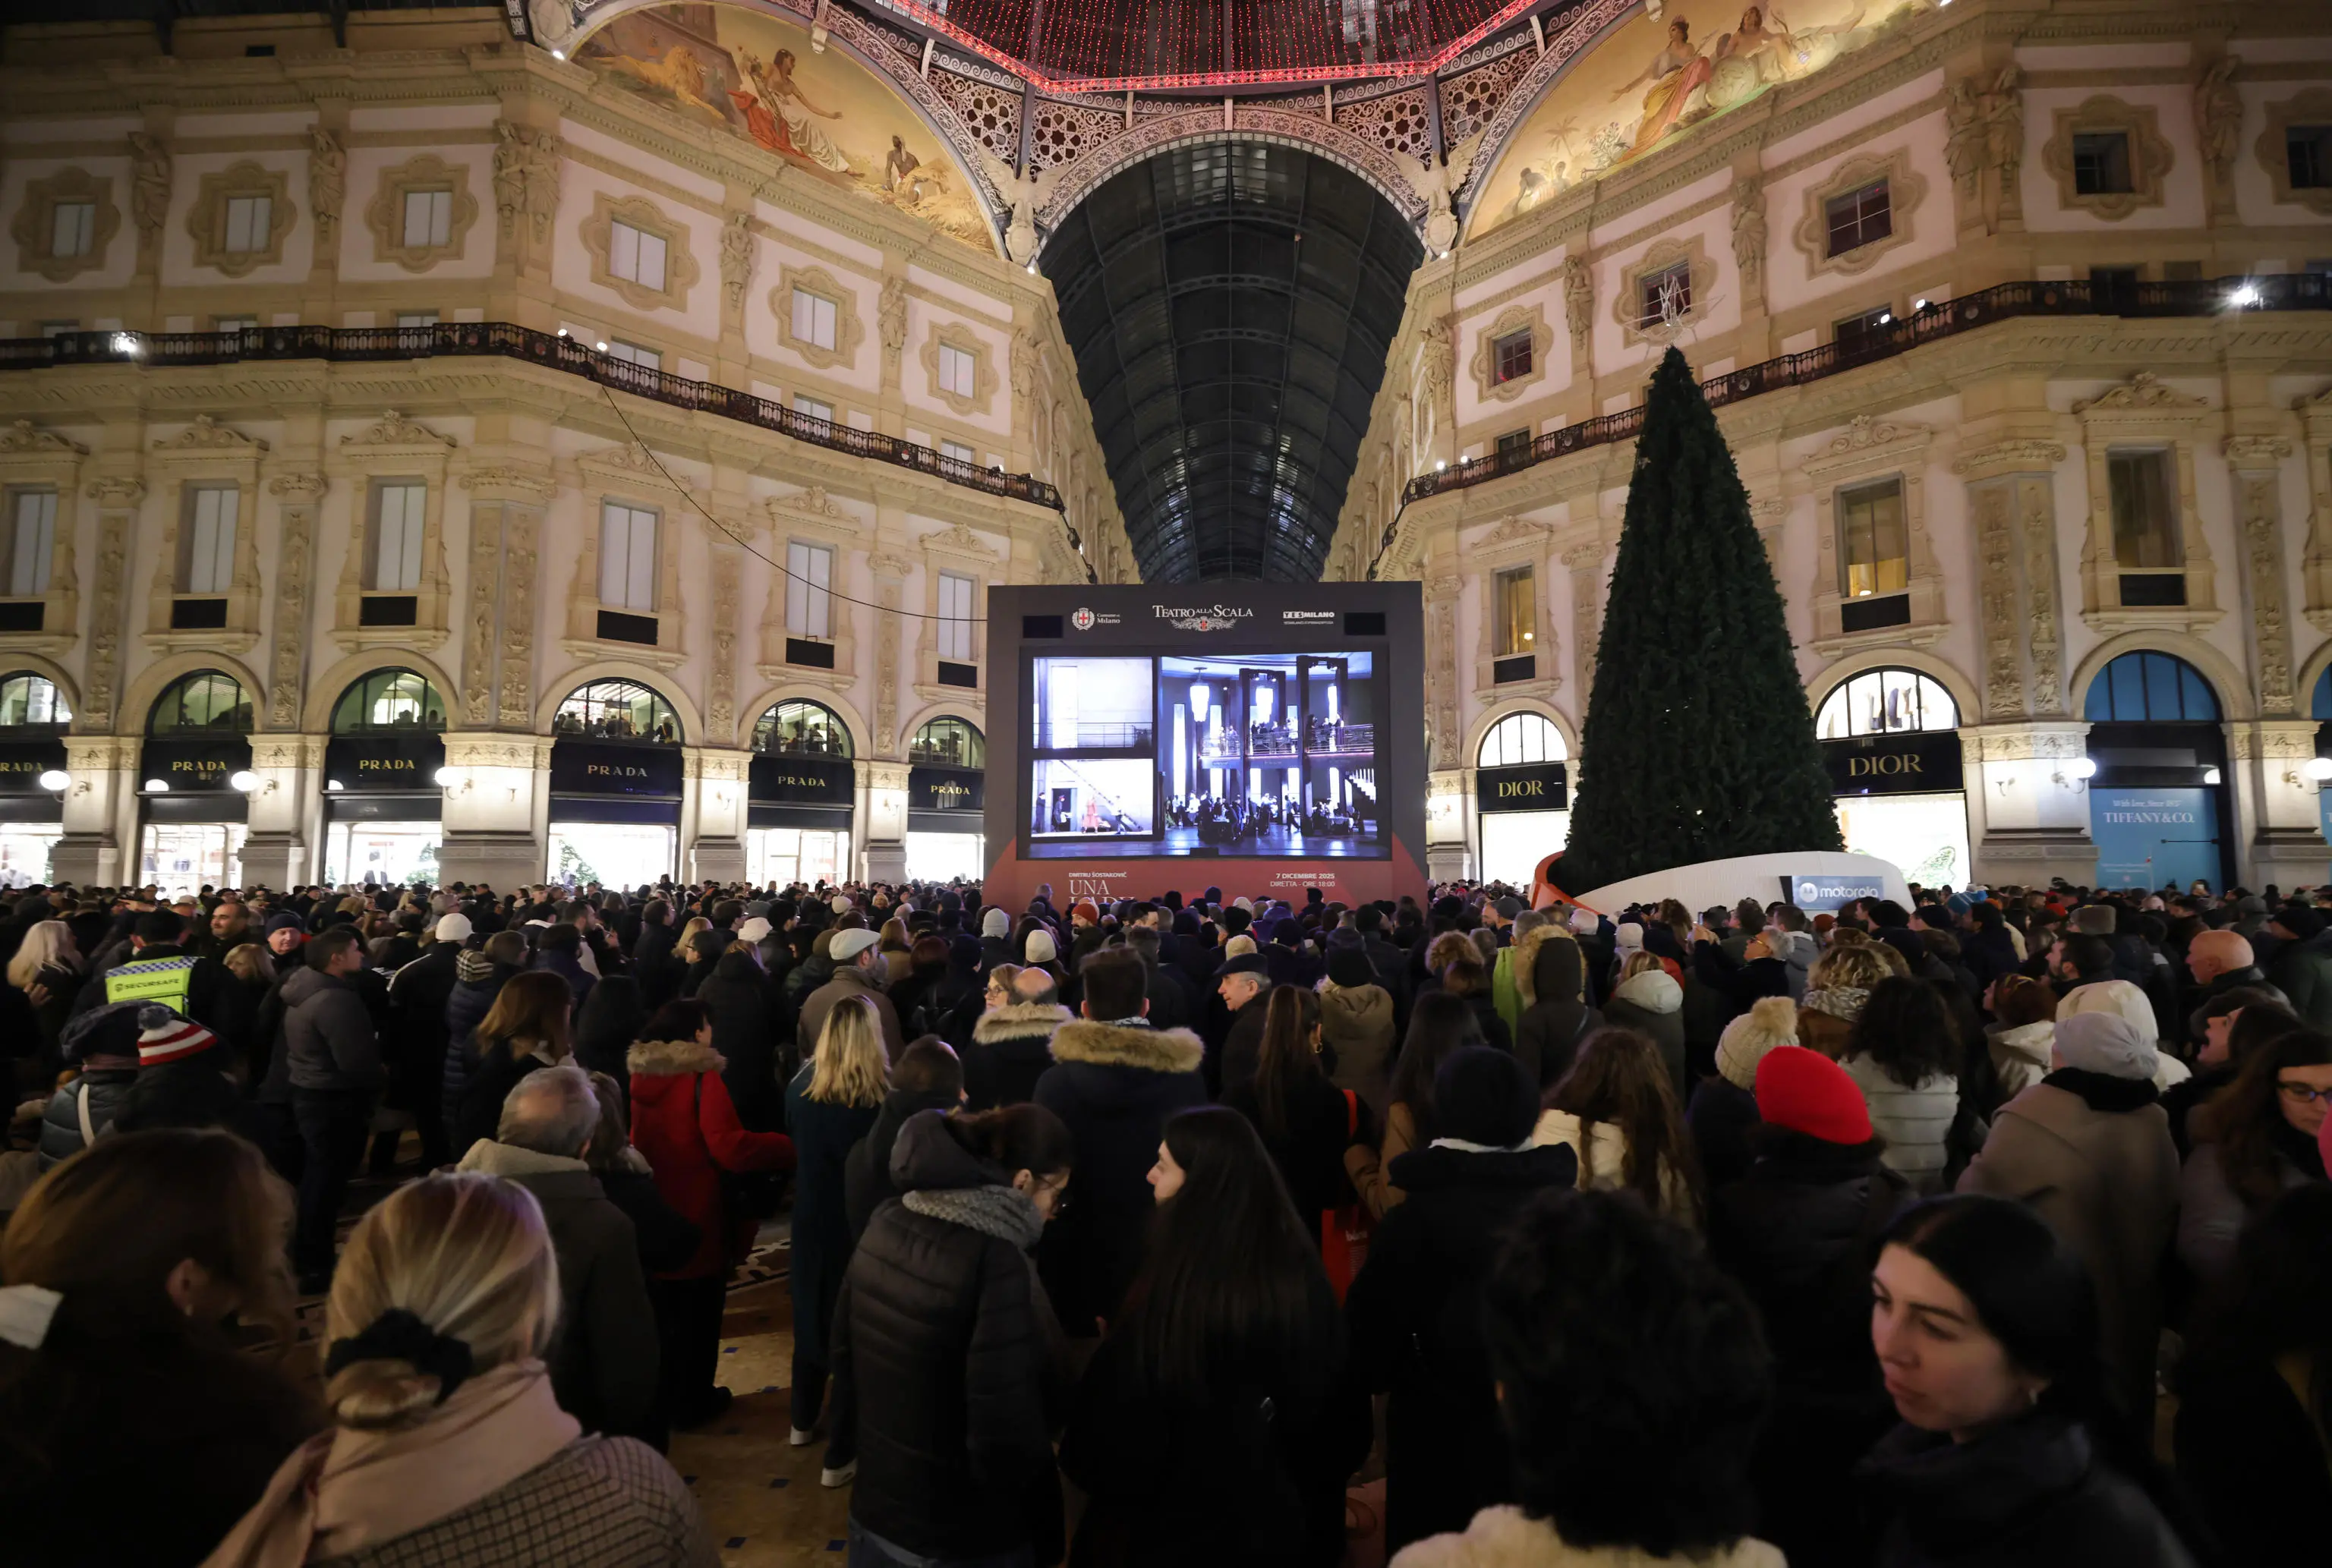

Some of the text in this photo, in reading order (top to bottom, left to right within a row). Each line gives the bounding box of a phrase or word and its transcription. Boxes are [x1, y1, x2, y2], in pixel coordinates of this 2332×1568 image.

[1152, 606, 1195, 617] TEATRO
[1214, 605, 1253, 616] SCALA
[0, 762, 43, 772] RADA
[172, 761, 227, 770] PRADA
[360, 760, 415, 770] PRADA
[588, 765, 648, 777] PRADA
[1848, 754, 1924, 776] DIOR
[778, 776, 826, 786] PRADA
[931, 785, 970, 795] PRADA
[1498, 780, 1545, 797] DIOR
[1069, 880, 1110, 895] UNA
[1820, 886, 1879, 898] motorola
